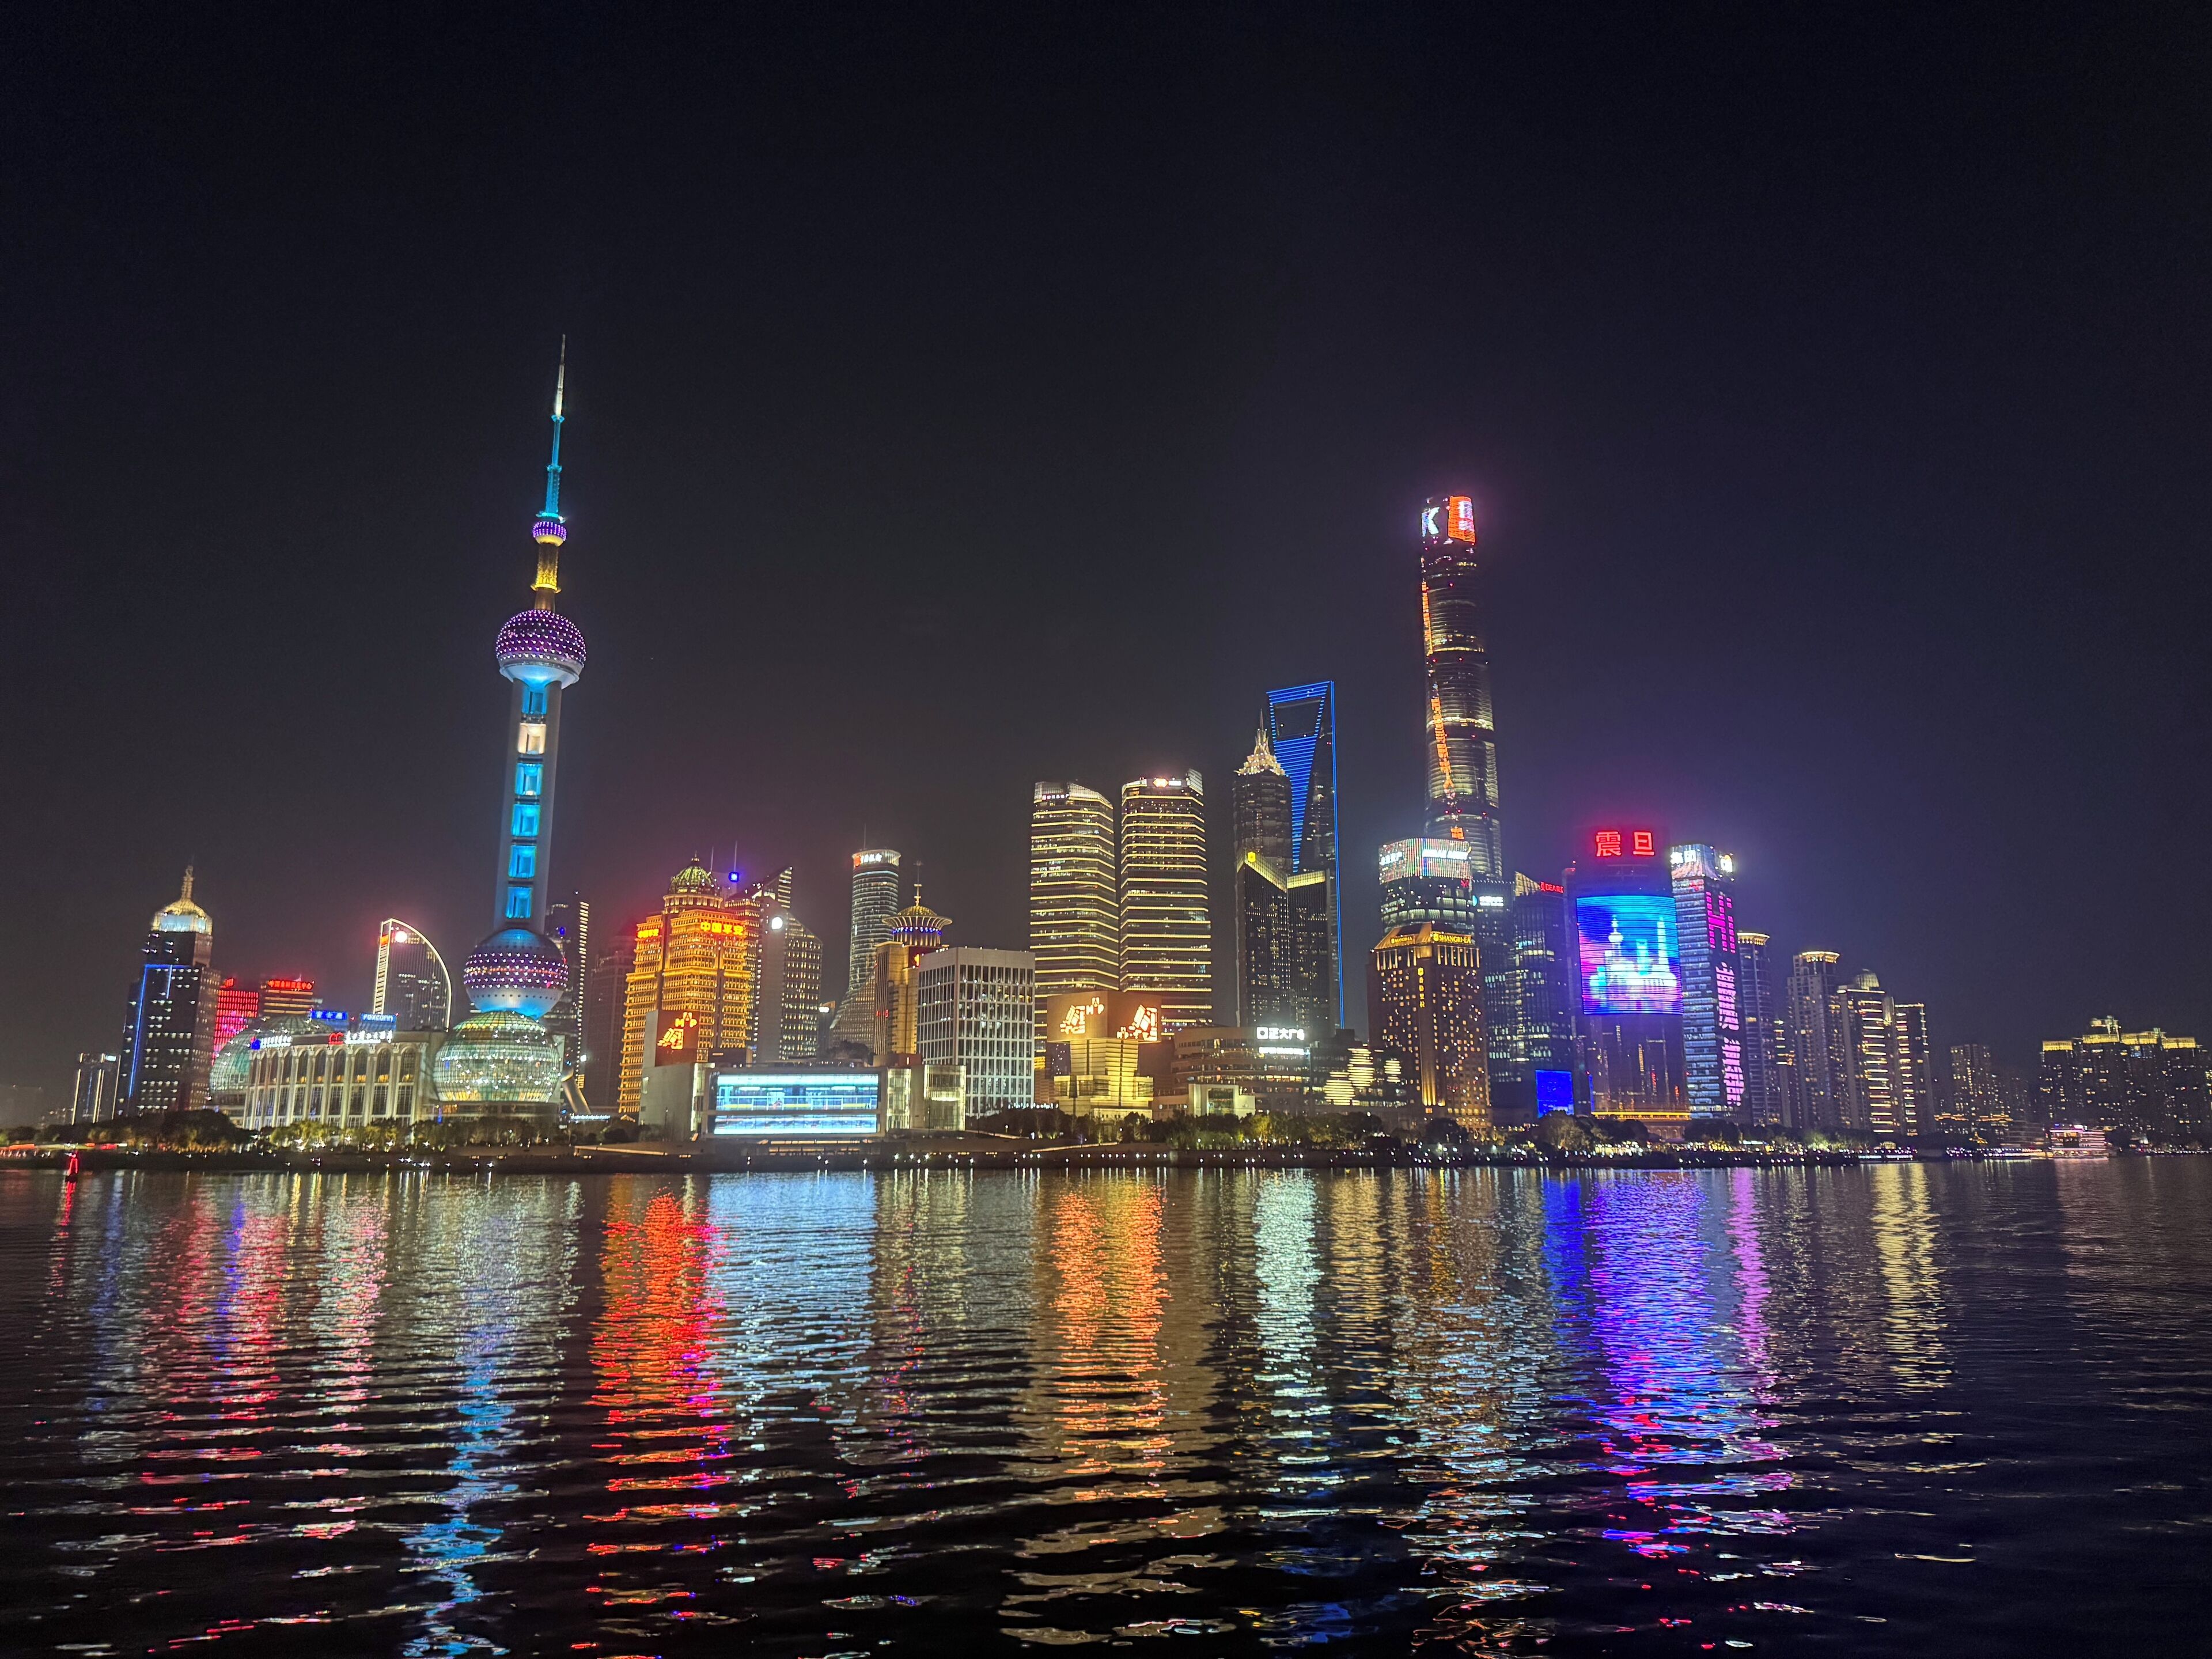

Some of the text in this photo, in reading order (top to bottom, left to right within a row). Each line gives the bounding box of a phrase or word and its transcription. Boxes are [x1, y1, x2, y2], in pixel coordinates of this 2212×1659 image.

[1596, 831, 1655, 857] 震旦
[700, 921, 744, 935] 中国平安
[1439, 934, 1471, 944] SHANGRI-LA
